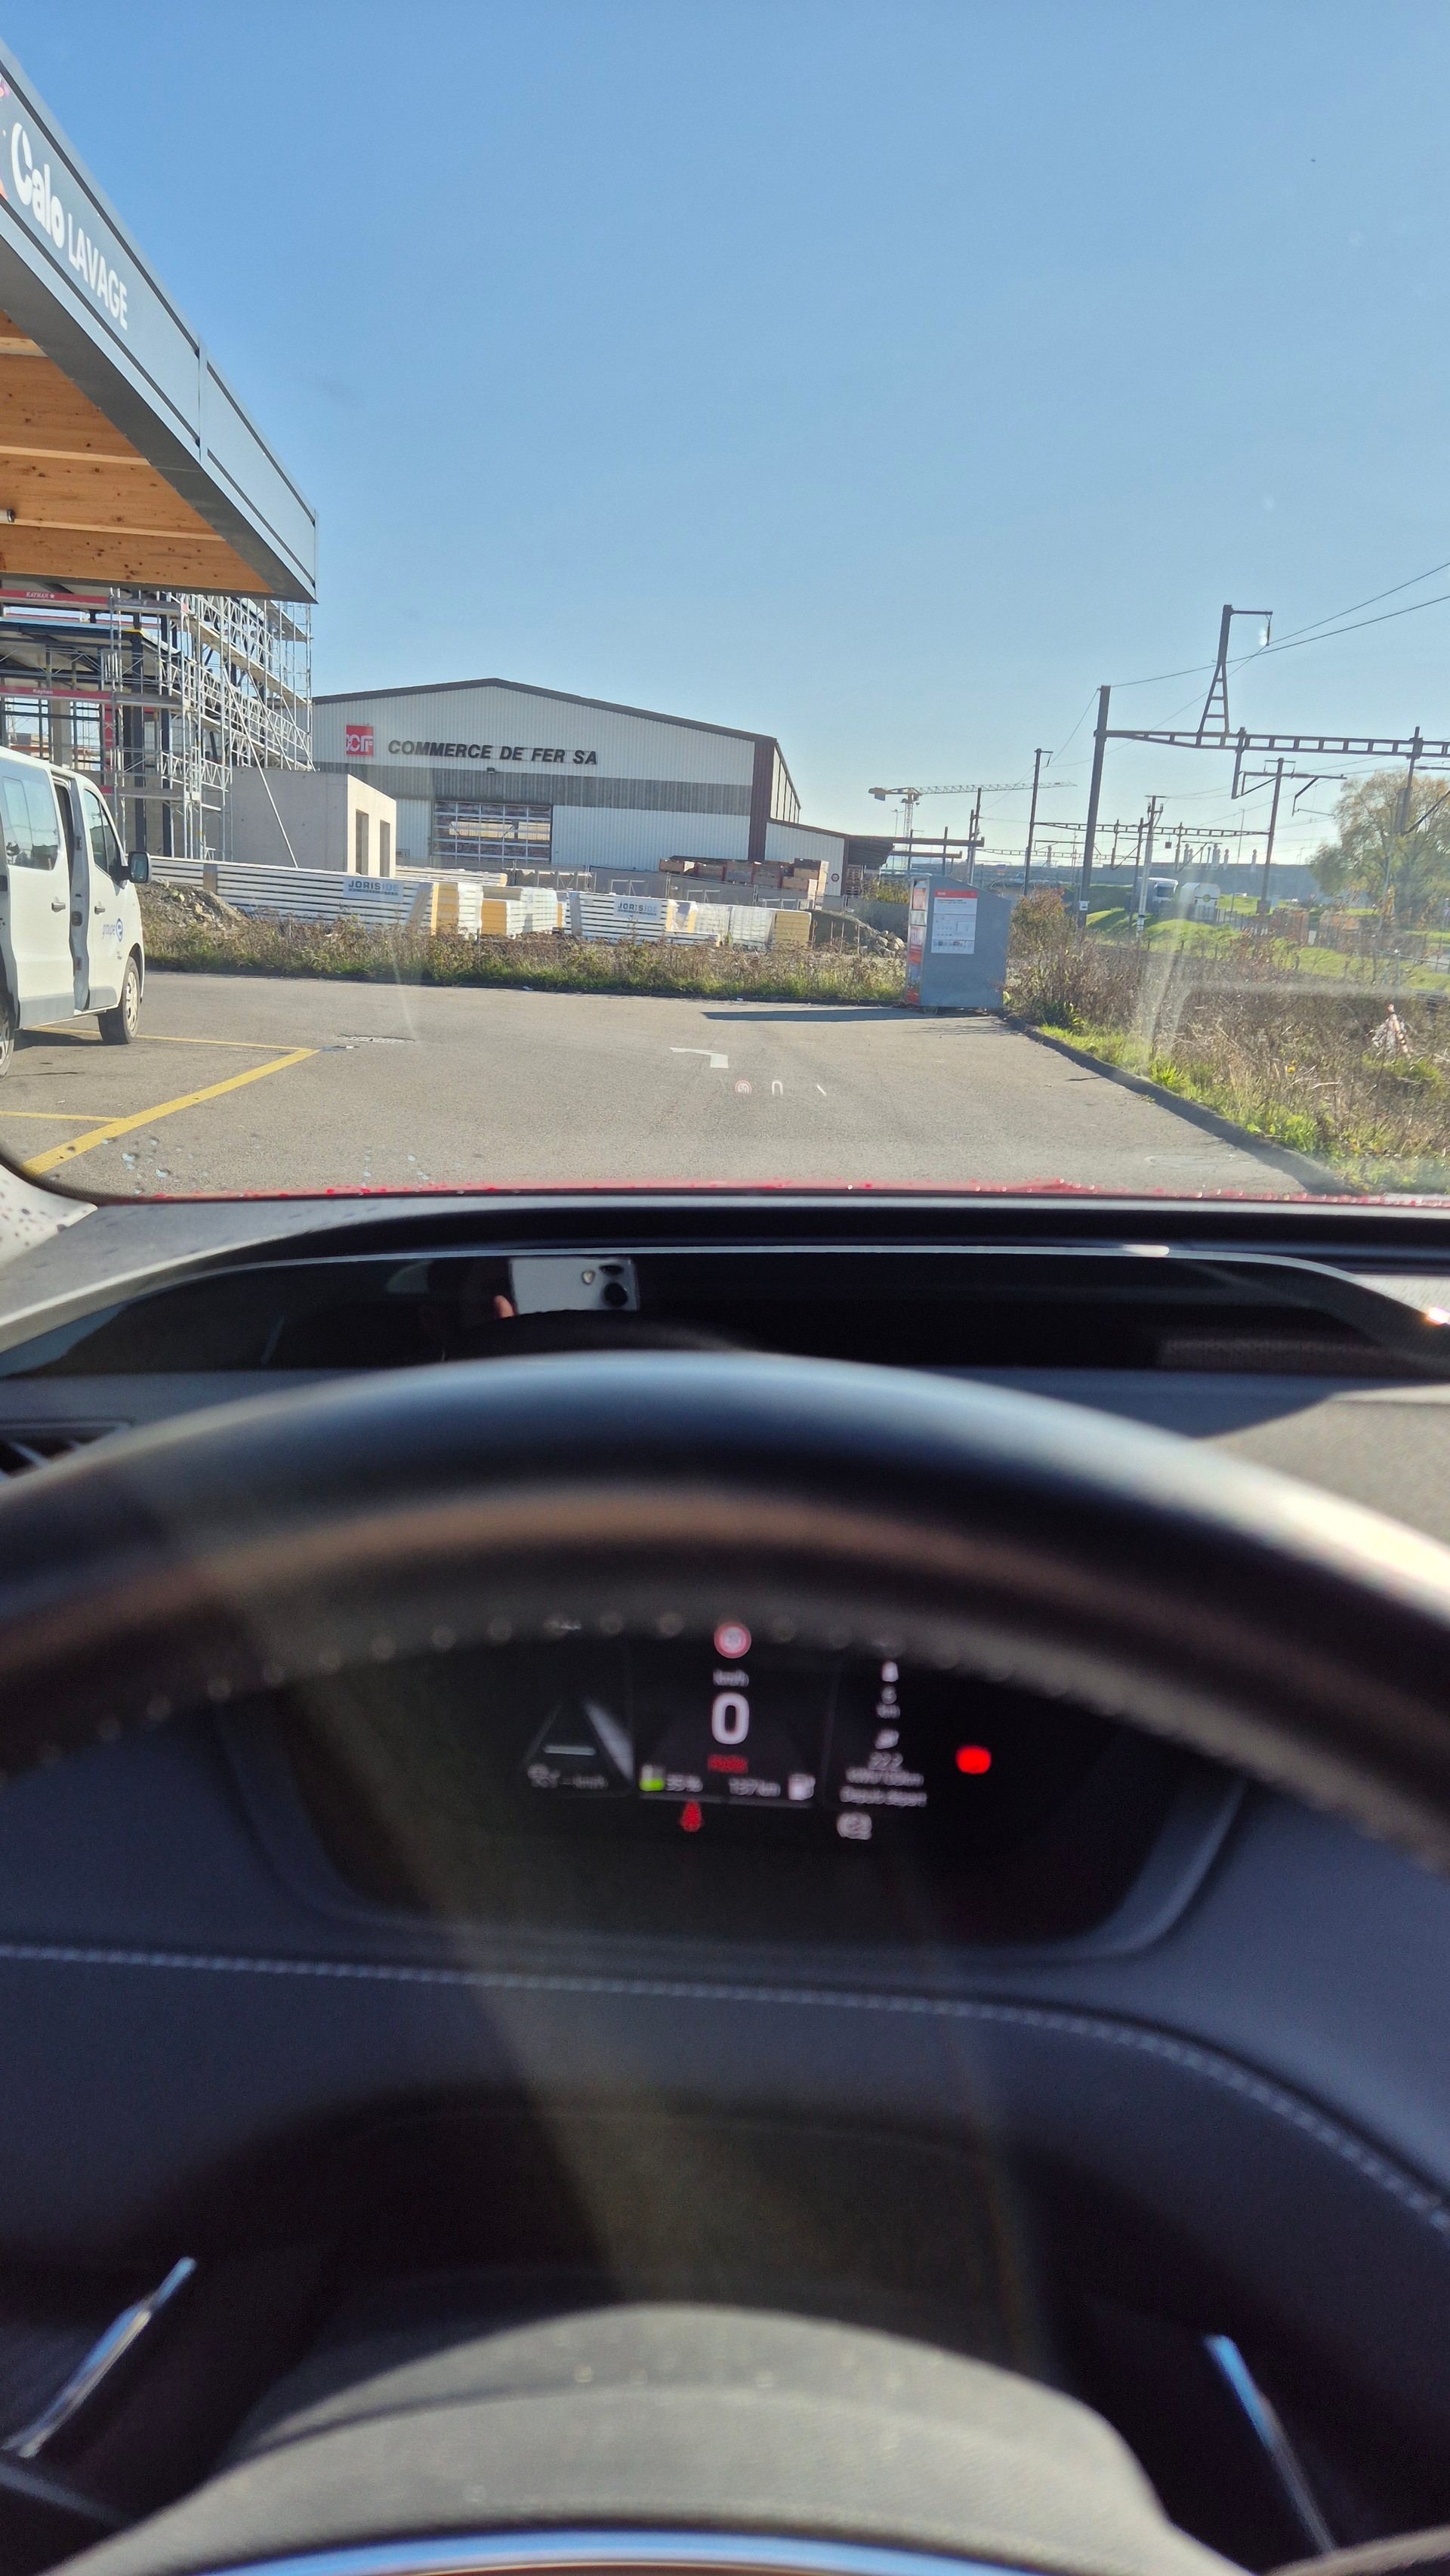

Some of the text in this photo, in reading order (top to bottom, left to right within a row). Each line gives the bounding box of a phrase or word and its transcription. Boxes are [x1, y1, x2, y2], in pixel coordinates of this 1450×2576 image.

[11, 122, 128, 332] Calo LAVAGE
[387, 740, 598, 765] COMMERCE DE FER SA
[711, 1691, 750, 1745] 0
